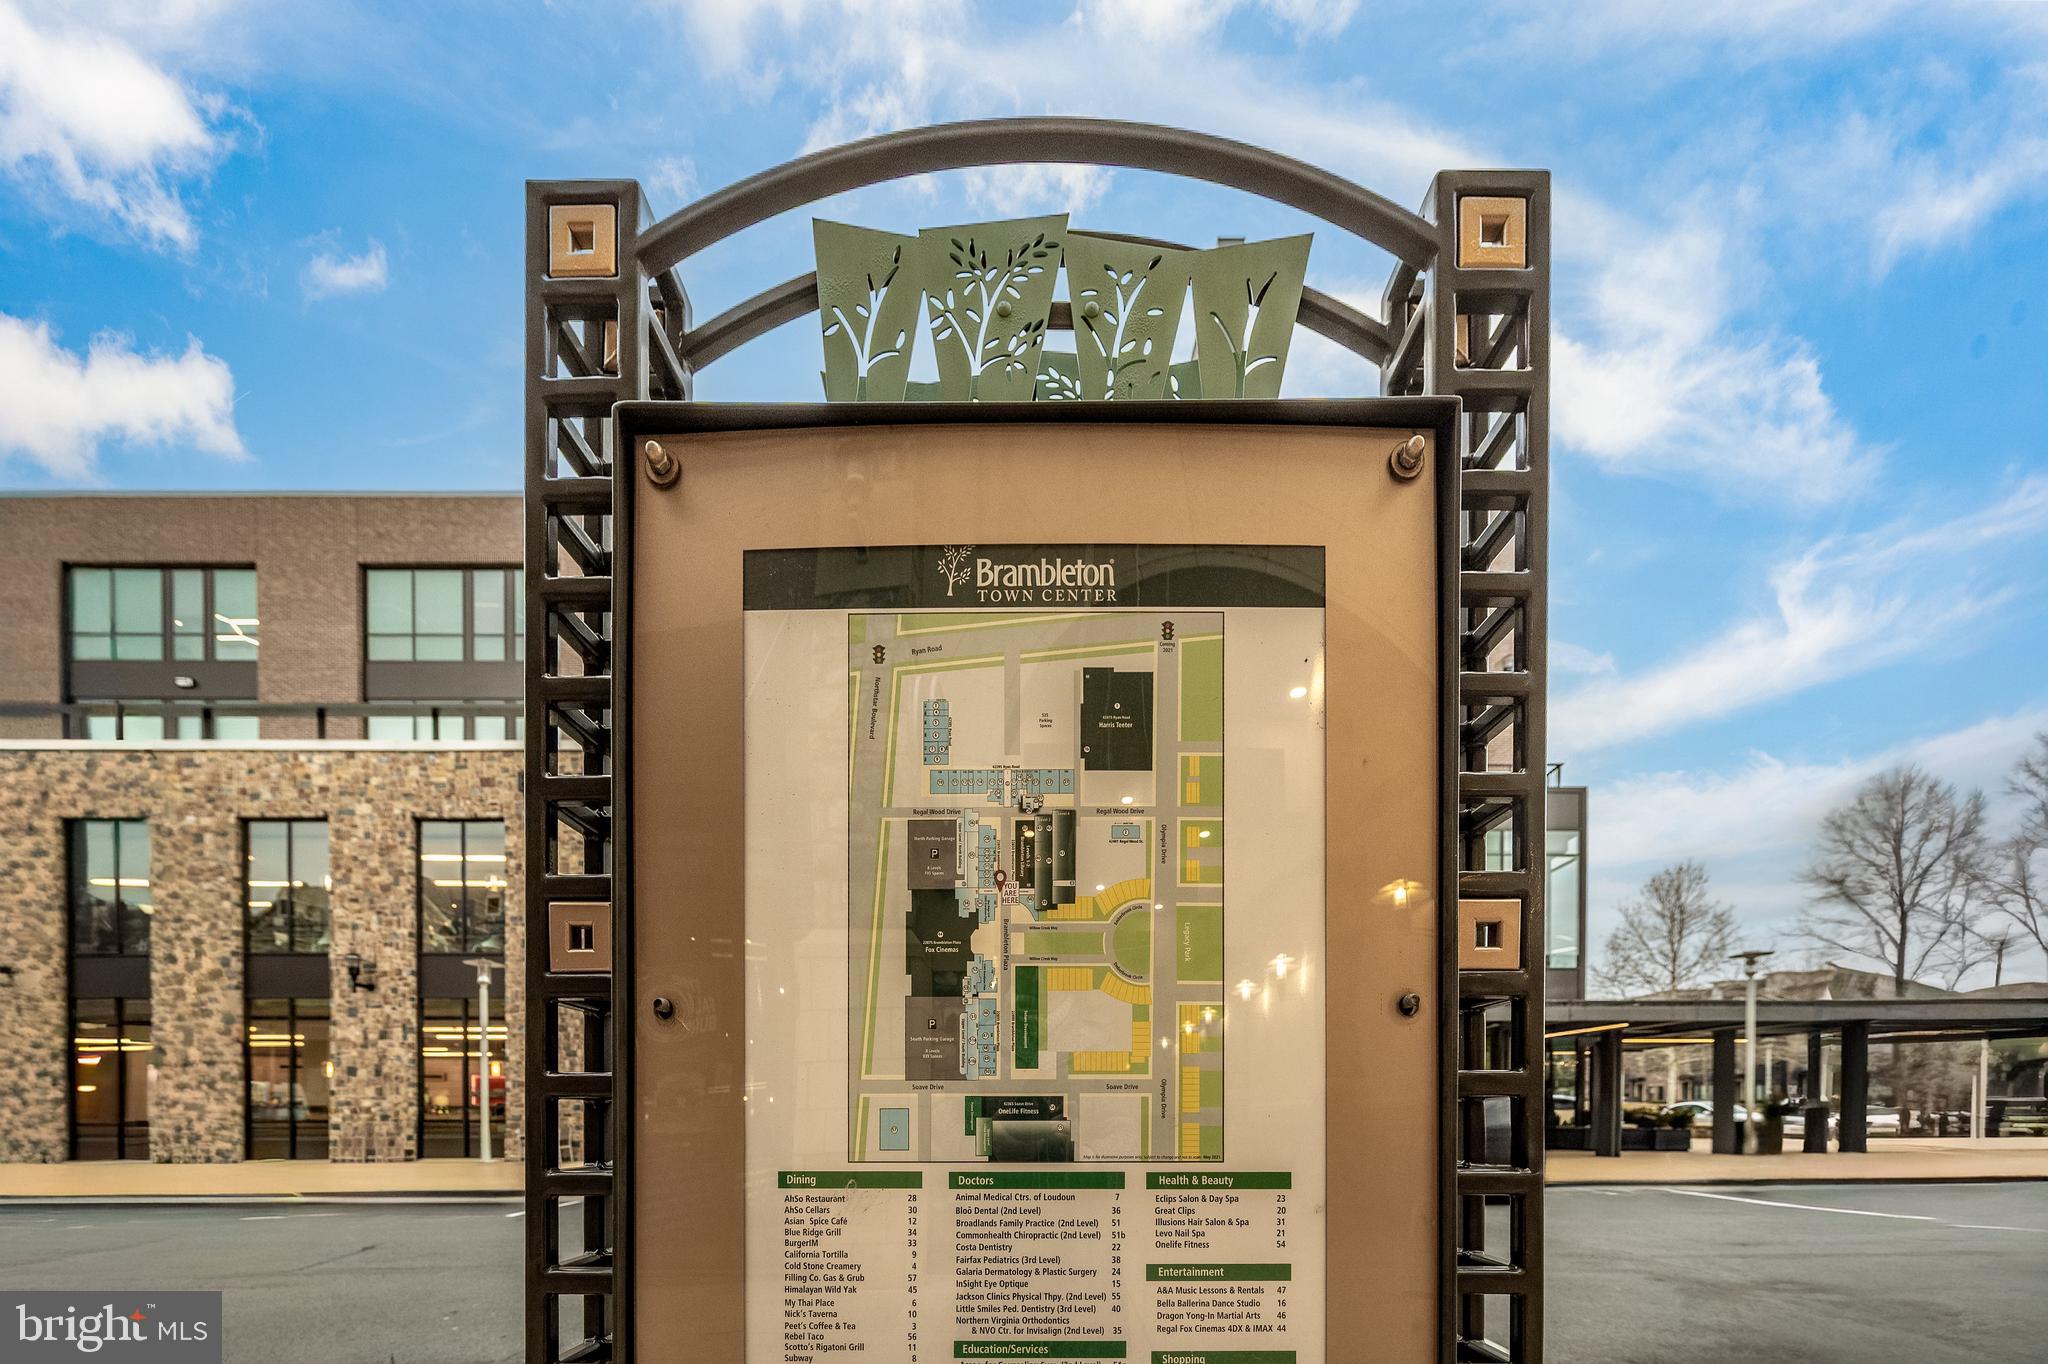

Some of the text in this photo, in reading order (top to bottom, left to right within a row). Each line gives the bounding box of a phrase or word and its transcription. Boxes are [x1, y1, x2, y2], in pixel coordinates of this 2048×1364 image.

[977, 558, 1115, 587] Brambleton
[977, 589, 1117, 602] TOWN CENTER
[870, 708, 878, 739] Boulevard
[787, 1174, 816, 1186] Dining
[958, 1176, 994, 1185] Doctors
[1159, 1175, 1234, 1187] Health & Beauty
[784, 1194, 804, 1202] AhSo
[984, 1193, 1012, 1201] Medical
[1034, 1193, 1042, 1201] of
[1156, 1194, 1176, 1204] Eclips
[1178, 1194, 1199, 1202] Salon
[1209, 1195, 1223, 1204] Day
[1225, 1195, 1239, 1204] Spa
[1178, 1206, 1196, 1216] Clips
[784, 1217, 804, 1225] Asian
[810, 1217, 829, 1226] Spice
[831, 1217, 848, 1225] Café
[956, 1219, 997, 1227] Broadlands
[1000, 1219, 1024, 1229] Family
[1026, 1219, 1055, 1227] Practice
[1058, 1219, 1074, 1228] (2nd
[1077, 1219, 1098, 1228] Level)
[956, 1231, 1012, 1239] Commonhealth
[1014, 1231, 1058, 1240] Chiropractic
[1060, 1231, 1077, 1240] (2nd
[1079, 1231, 1101, 1240] Level)
[1175, 1229, 1189, 1237] Nail
[1192, 1229, 1205, 1238] Spa
[956, 1243, 976, 1251] Costa
[979, 1243, 1012, 1253] Dentistry
[1156, 1240, 1182, 1248] Onelife
[784, 1250, 820, 1258] California
[822, 1250, 848, 1258] Tortilla
[784, 1262, 801, 1270] Cold
[803, 1262, 824, 1270] Stone
[826, 1262, 861, 1272] Creamery
[1158, 1266, 1224, 1276] Entertainment
[985, 1268, 1032, 1278] Dermatology
[1042, 1268, 1066, 1276] Plastic
[1068, 1268, 1097, 1278] Surgery
[784, 1285, 822, 1295] Himalayan
[956, 1280, 982, 1290] InSight
[984, 1280, 997, 1290] Eye
[999, 1280, 1028, 1290] Optique
[1157, 1299, 1175, 1307] Bella
[1178, 1299, 1210, 1307] Ballerina
[1237, 1299, 1260, 1307] Studio
[956, 1316, 1070, 1326] Northern Virginia Orthodontics
[1157, 1312, 1184, 1322] Dragon
[1186, 1312, 1214, 1321] Yong-In
[1217, 1311, 1243, 1319] Martial
[809, 1322, 833, 1330] Coffee
[784, 1332, 805, 1340] Rebel
[963, 1344, 1048, 1354] Education/Services
[784, 1354, 813, 1364] Subway
